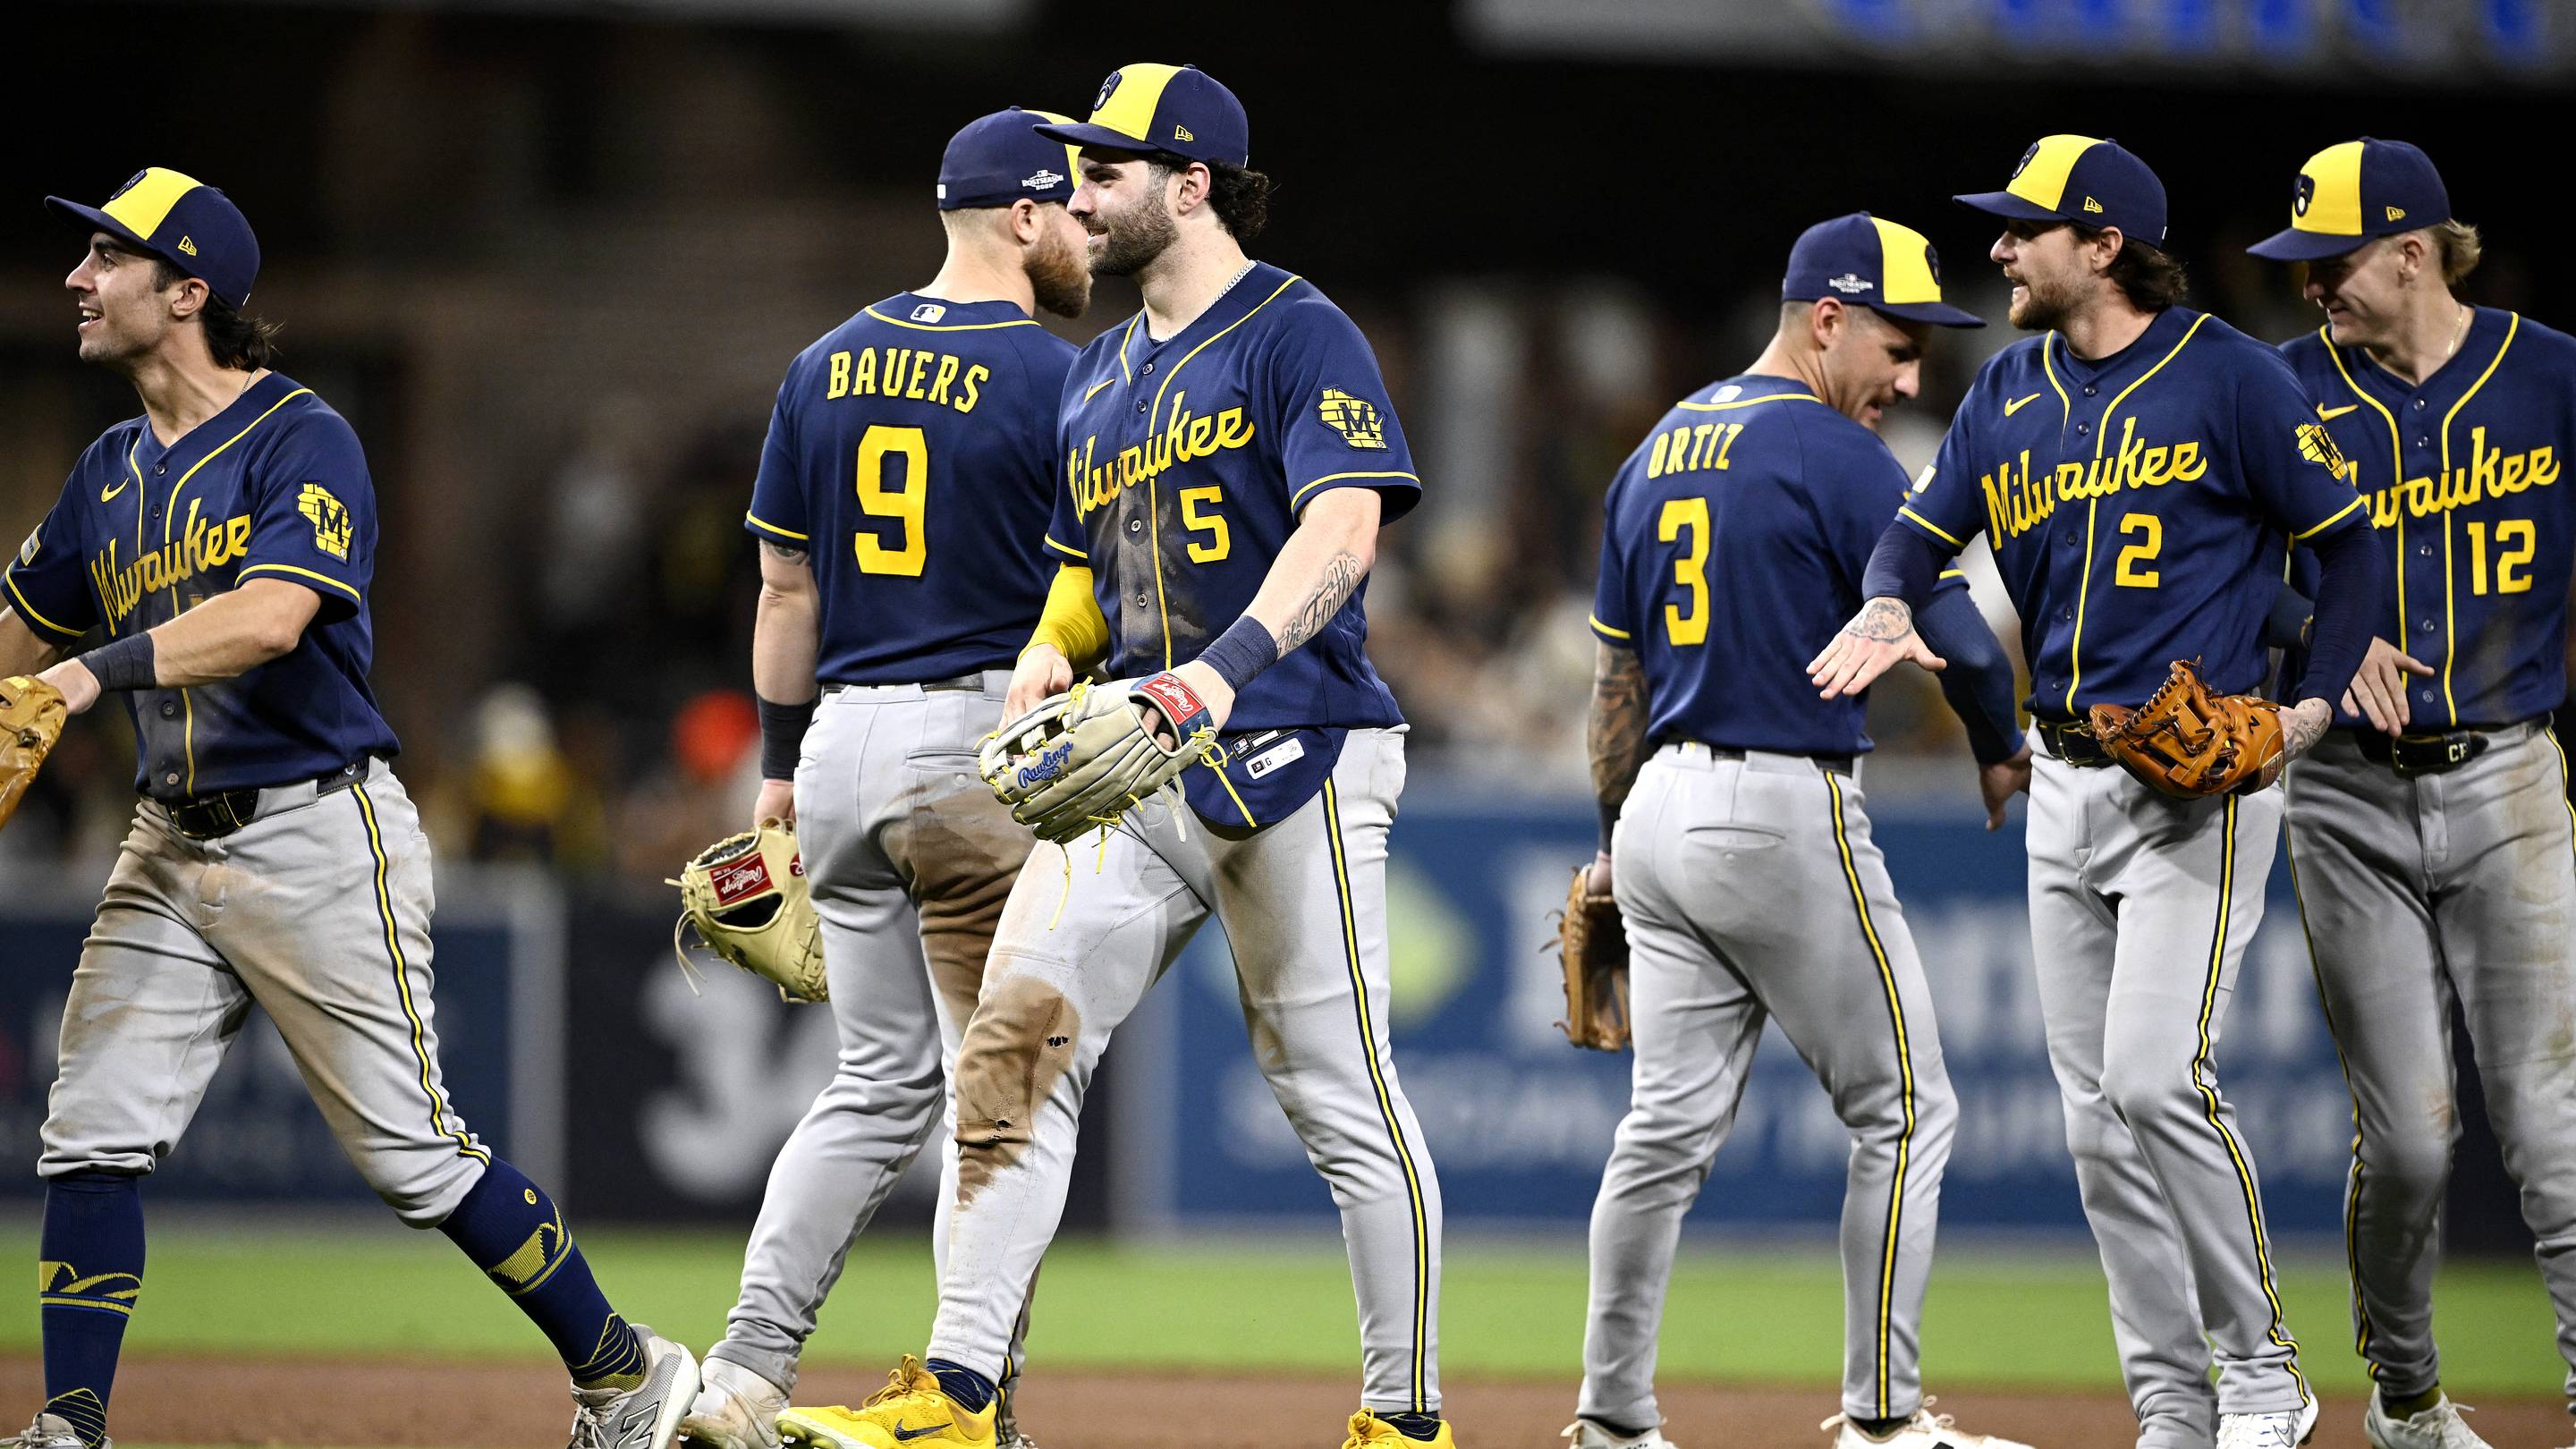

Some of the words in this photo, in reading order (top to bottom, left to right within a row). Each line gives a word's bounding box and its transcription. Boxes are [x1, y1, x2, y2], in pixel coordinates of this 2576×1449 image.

[827, 348, 989, 414] BAUERS
[1338, 402, 1377, 437] M
[1647, 423, 1744, 479] ORTIZ
[318, 498, 350, 546] M
[854, 424, 928, 578] 9
[1981, 417, 2207, 551] Milwaukee
[1179, 486, 1231, 564] 5
[2114, 513, 2163, 589] 2
[2467, 519, 2537, 597] 12
[91, 497, 251, 638] Milwaukee
[1658, 496, 1710, 647] 3
[1017, 741, 1074, 789] Rawlings
[720, 865, 763, 894] Rawlings
